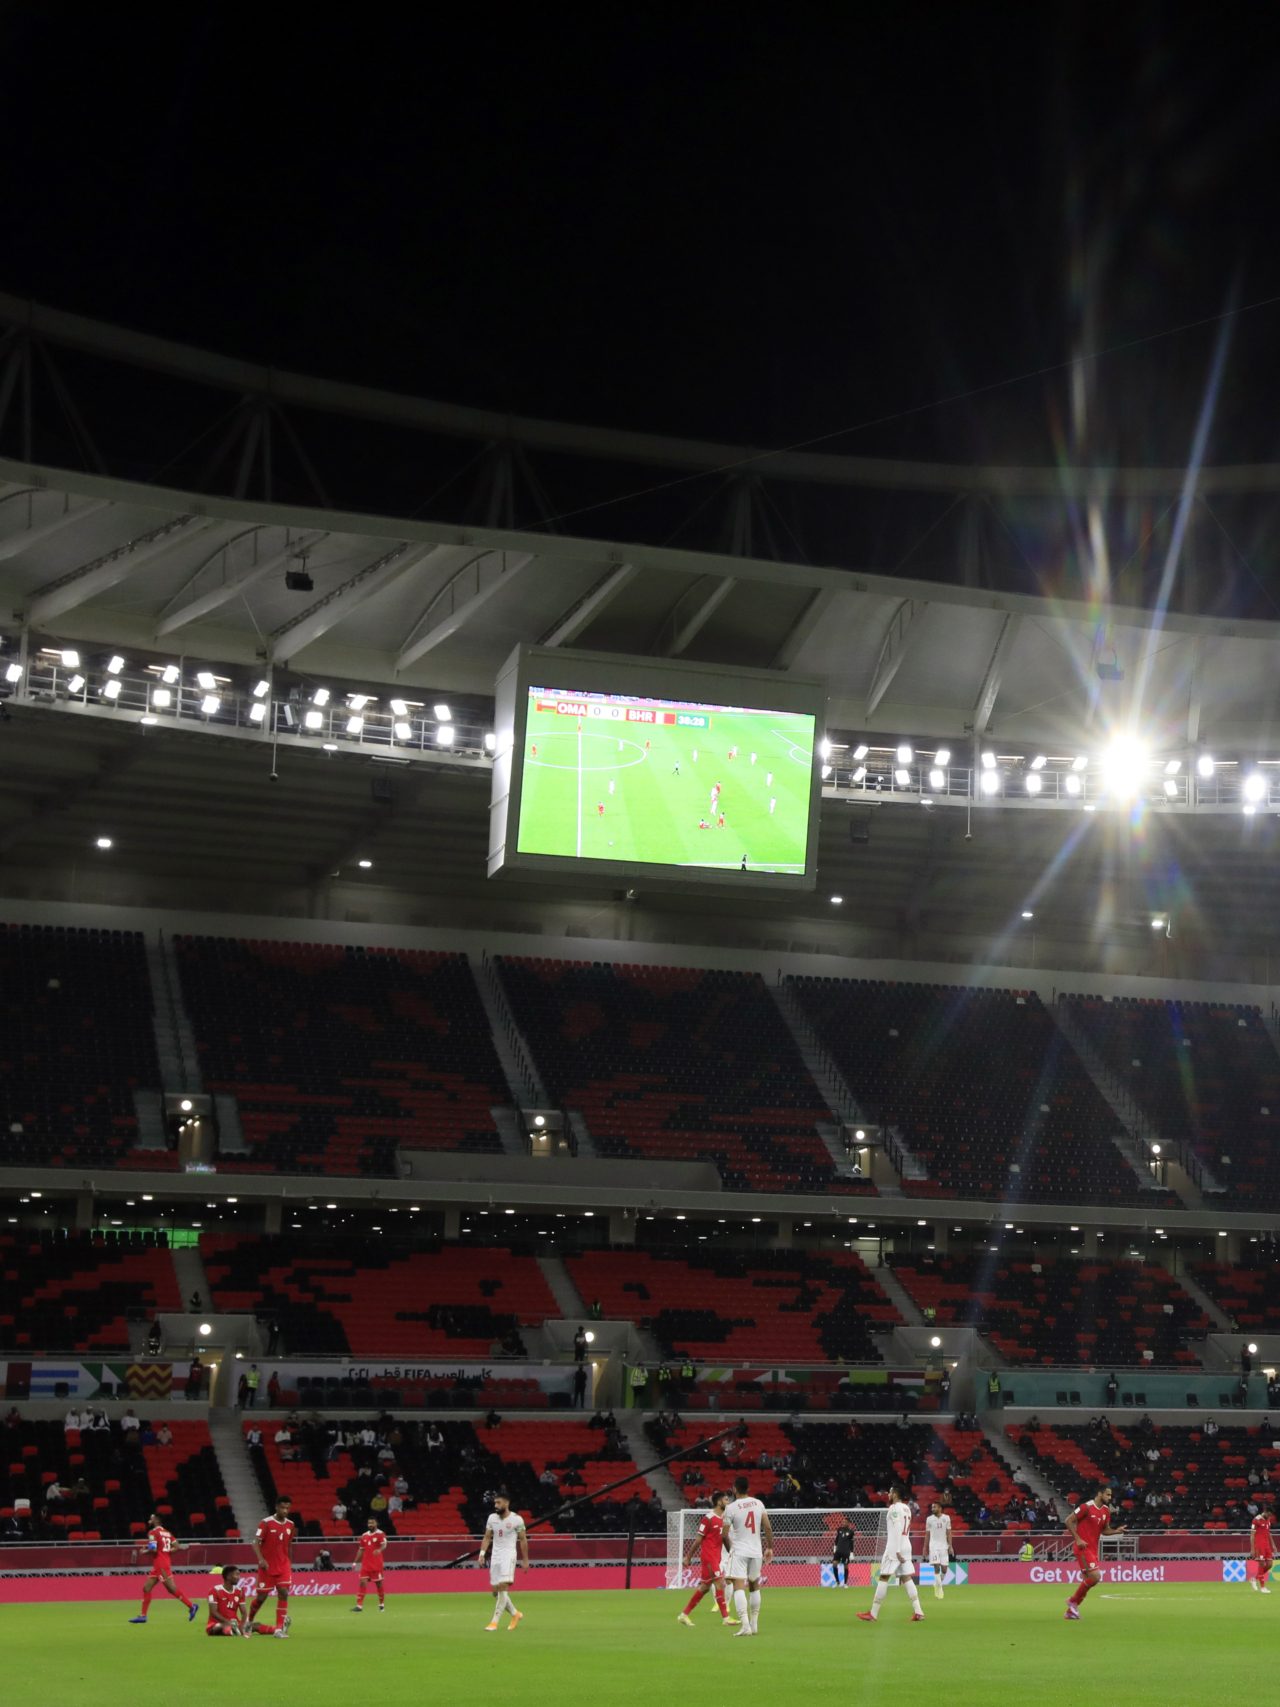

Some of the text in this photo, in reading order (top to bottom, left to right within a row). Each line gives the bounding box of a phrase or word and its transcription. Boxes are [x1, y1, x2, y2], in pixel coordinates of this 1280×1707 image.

[557, 703, 586, 716] OMA
[594, 707, 600, 717] 0
[612, 708, 619, 719] 0
[628, 710, 653, 723] BHR
[404, 1369, 431, 1379] FIFA
[745, 1511, 756, 1534] 4
[162, 1537, 171, 1552] 13
[1030, 1565, 1164, 1583] Get yor ticket!
